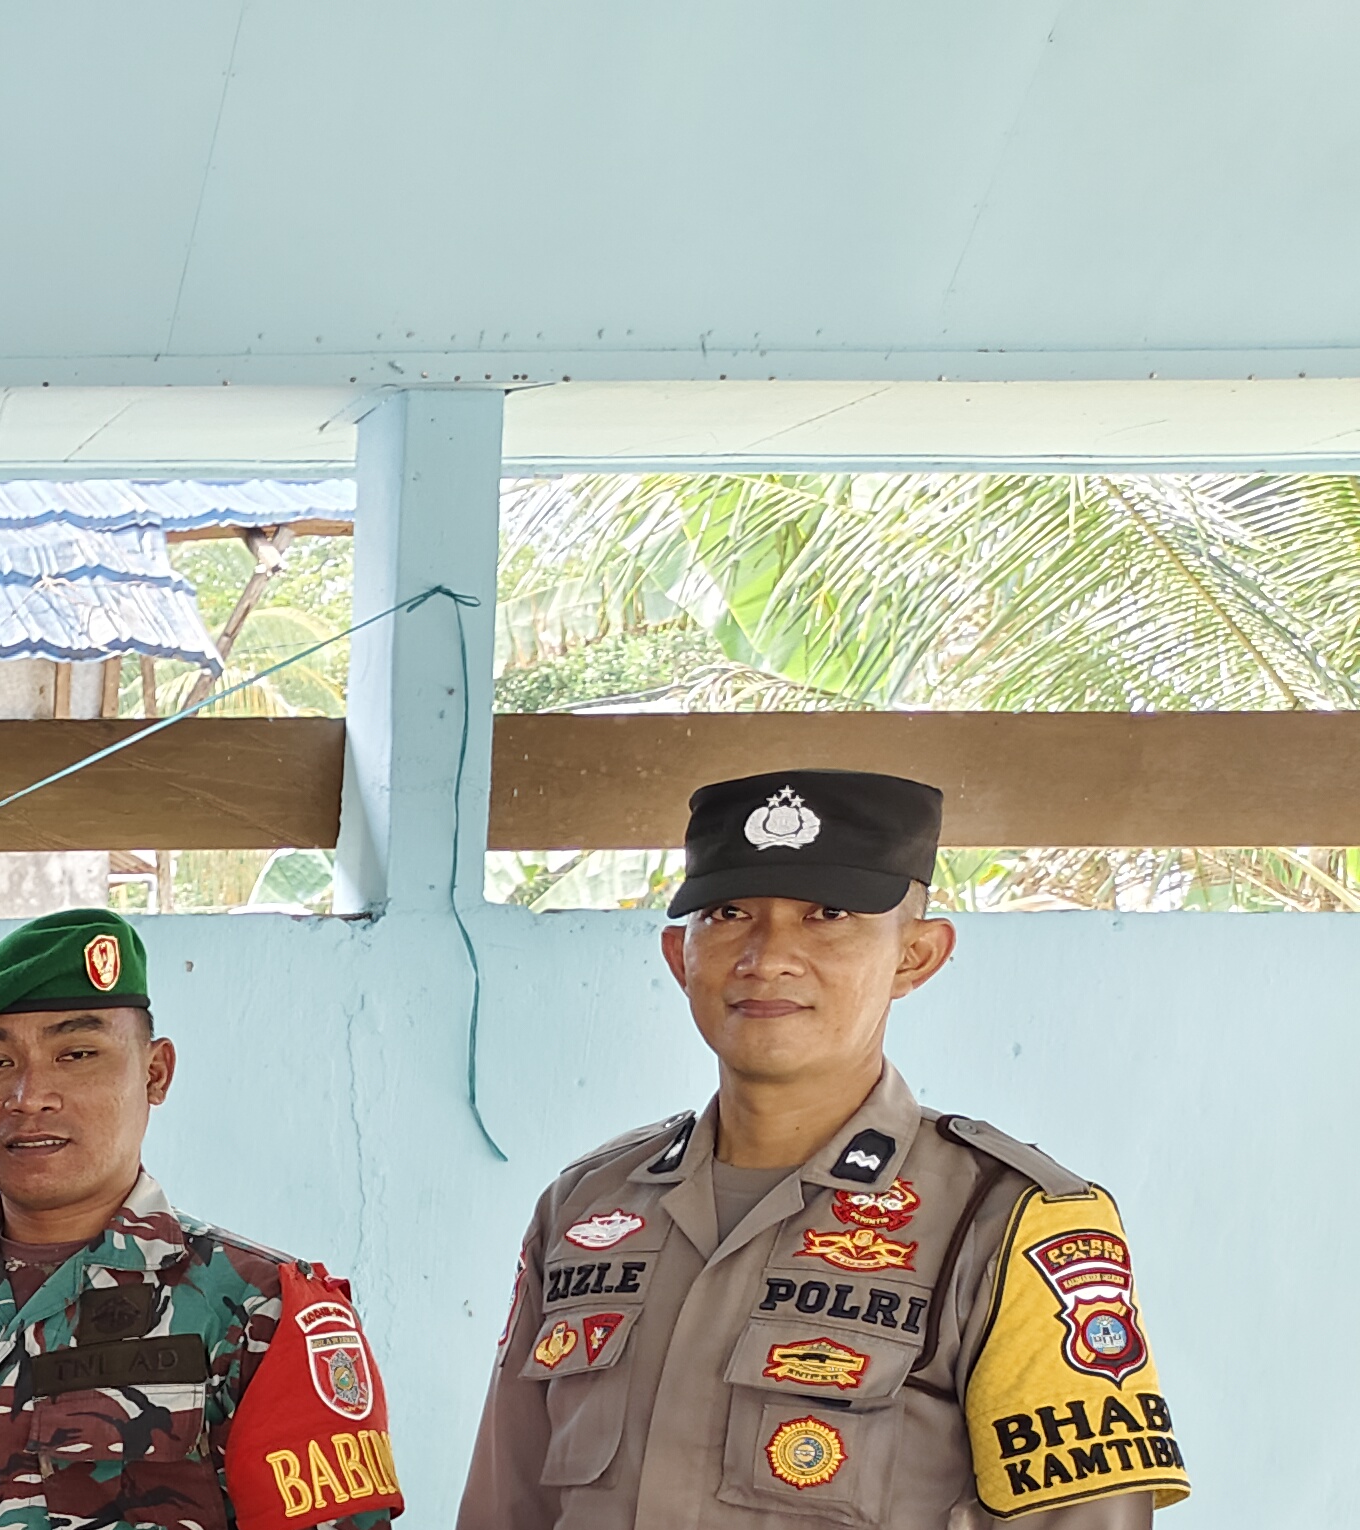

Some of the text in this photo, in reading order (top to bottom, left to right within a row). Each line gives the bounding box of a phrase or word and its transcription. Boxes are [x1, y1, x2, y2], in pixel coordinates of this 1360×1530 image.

[1047, 1239, 1124, 1262] POLRES
[1056, 1250, 1123, 1265] TAPIN
[546, 1262, 646, 1303] ZIZI.E
[758, 1277, 928, 1335] POLRI
[129, 1349, 179, 1373] AD
